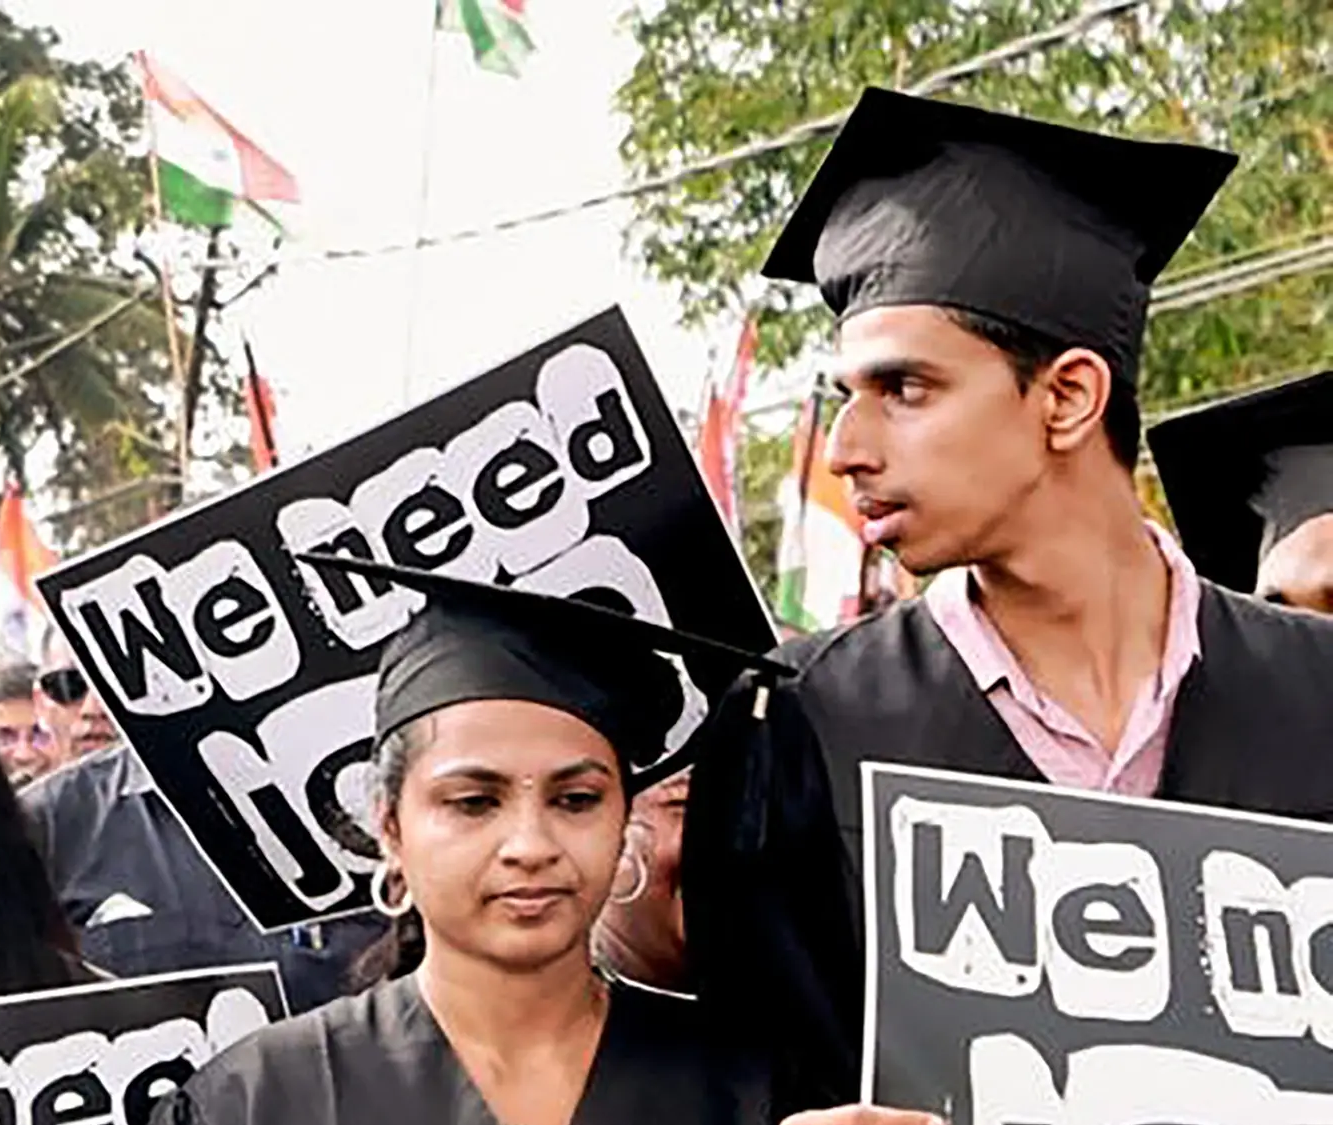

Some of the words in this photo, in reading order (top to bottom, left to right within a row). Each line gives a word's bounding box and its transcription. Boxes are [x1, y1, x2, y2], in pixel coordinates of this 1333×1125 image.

[79, 570, 275, 696] We
[309, 387, 644, 614] need
[912, 820, 1158, 972] We
